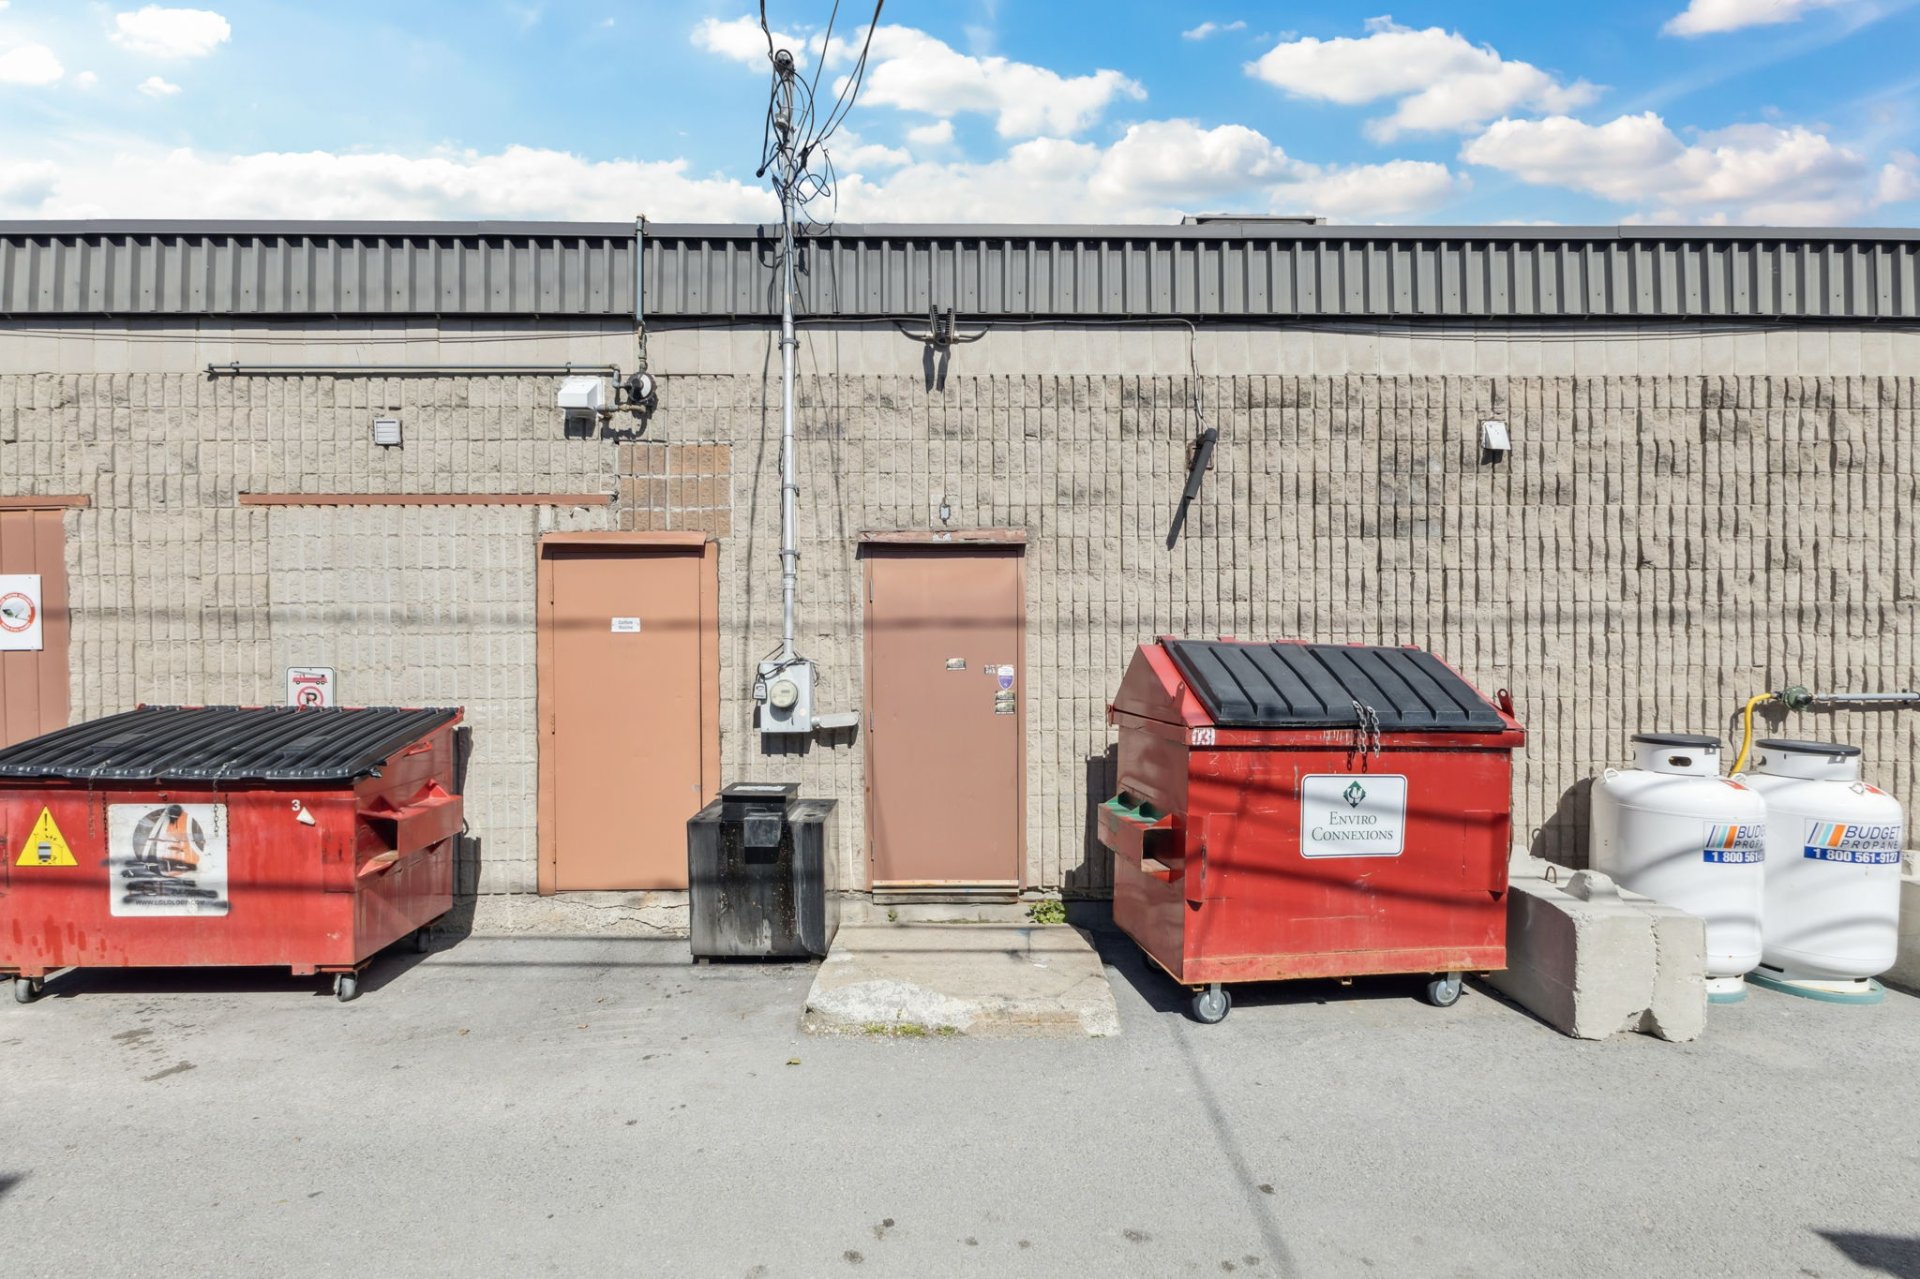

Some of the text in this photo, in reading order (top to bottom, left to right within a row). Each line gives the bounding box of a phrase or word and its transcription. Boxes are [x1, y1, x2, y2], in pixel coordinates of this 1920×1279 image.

[291, 799, 301, 811] 3
[1329, 811, 1377, 826] ENVIRO
[1311, 826, 1394, 842] CONNEXIONS
[1844, 825, 1901, 840] BUDGET
[1840, 840, 1899, 850] PROPANE
[1712, 851, 1719, 862] 1
[1722, 851, 1743, 863] 800
[1813, 849, 1898, 864] 1 800 561-9127
